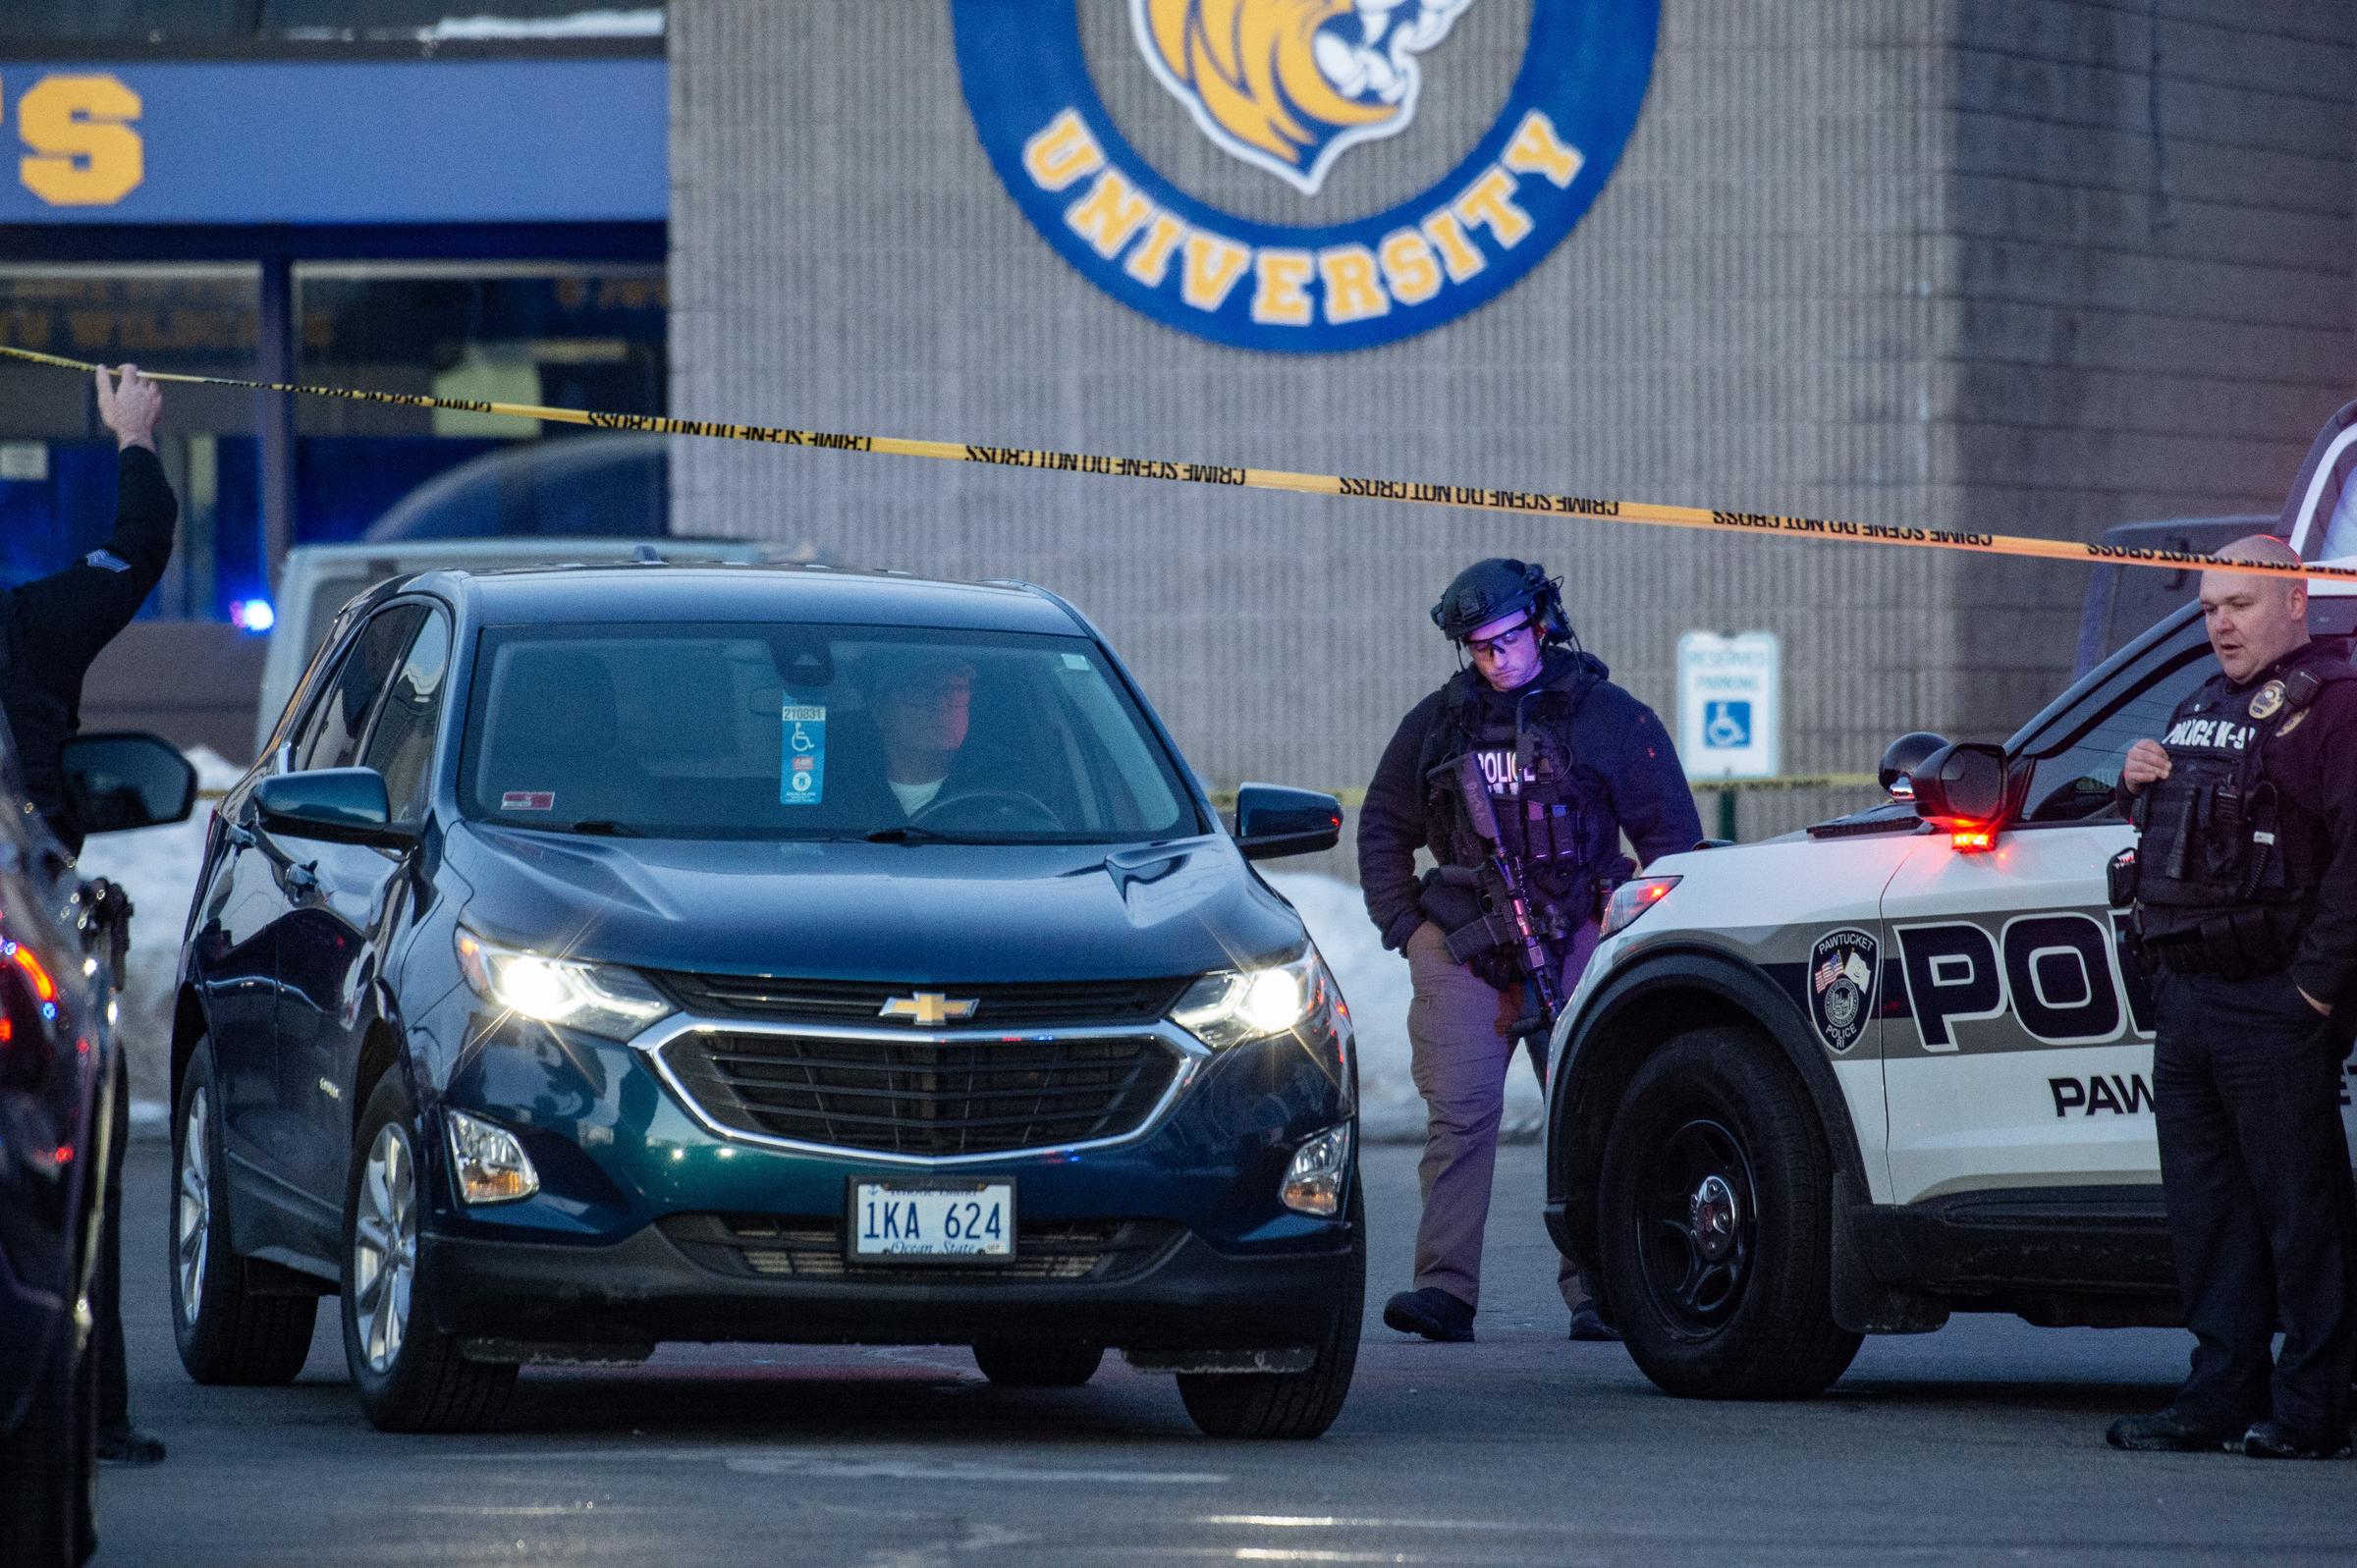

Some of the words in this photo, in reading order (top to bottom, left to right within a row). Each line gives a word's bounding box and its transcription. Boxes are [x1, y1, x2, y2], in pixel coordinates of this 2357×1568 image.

[0, 72, 144, 206] S
[1021, 107, 1586, 326] UNIVERSITY
[965, 446, 1034, 466] CROSS
[1037, 451, 1077, 470] NOT
[1081, 455, 1111, 473] DO
[1113, 459, 1178, 479] SCENE
[1181, 464, 1246, 484] CRIME
[1339, 478, 1407, 497] CROSS
[1410, 483, 1451, 501] NOT
[1454, 487, 1484, 504] DO
[1487, 491, 1553, 509] SCENE
[1555, 497, 1619, 514] CRIME
[1818, 933, 1874, 955] PAWTUCKET
[1826, 1023, 1857, 1040] POLICE
[1836, 1038, 1845, 1049] RI
[864, 1202, 920, 1240] 1KA
[945, 1202, 1001, 1240] 624
[890, 1240, 933, 1255] Ocean
[937, 1239, 975, 1255] State
